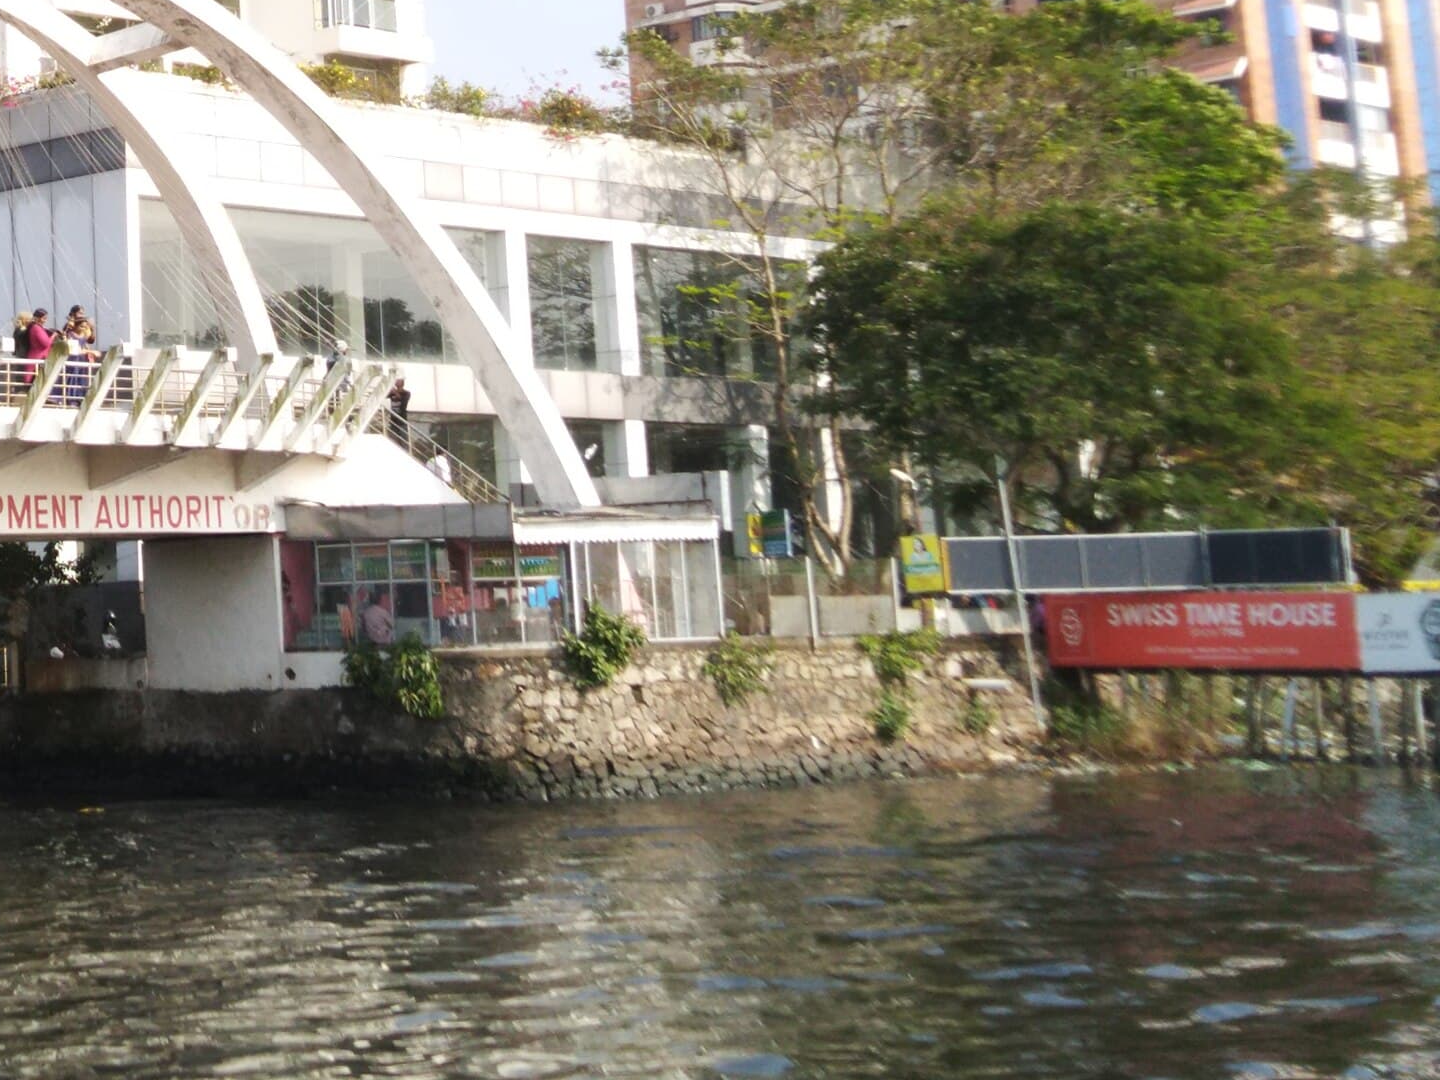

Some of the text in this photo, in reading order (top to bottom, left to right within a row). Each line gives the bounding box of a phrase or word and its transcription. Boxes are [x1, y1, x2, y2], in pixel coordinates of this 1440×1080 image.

[95, 495, 236, 529] AUTHORIT
[1106, 602, 1337, 627] SWISS TIME HOUSE
